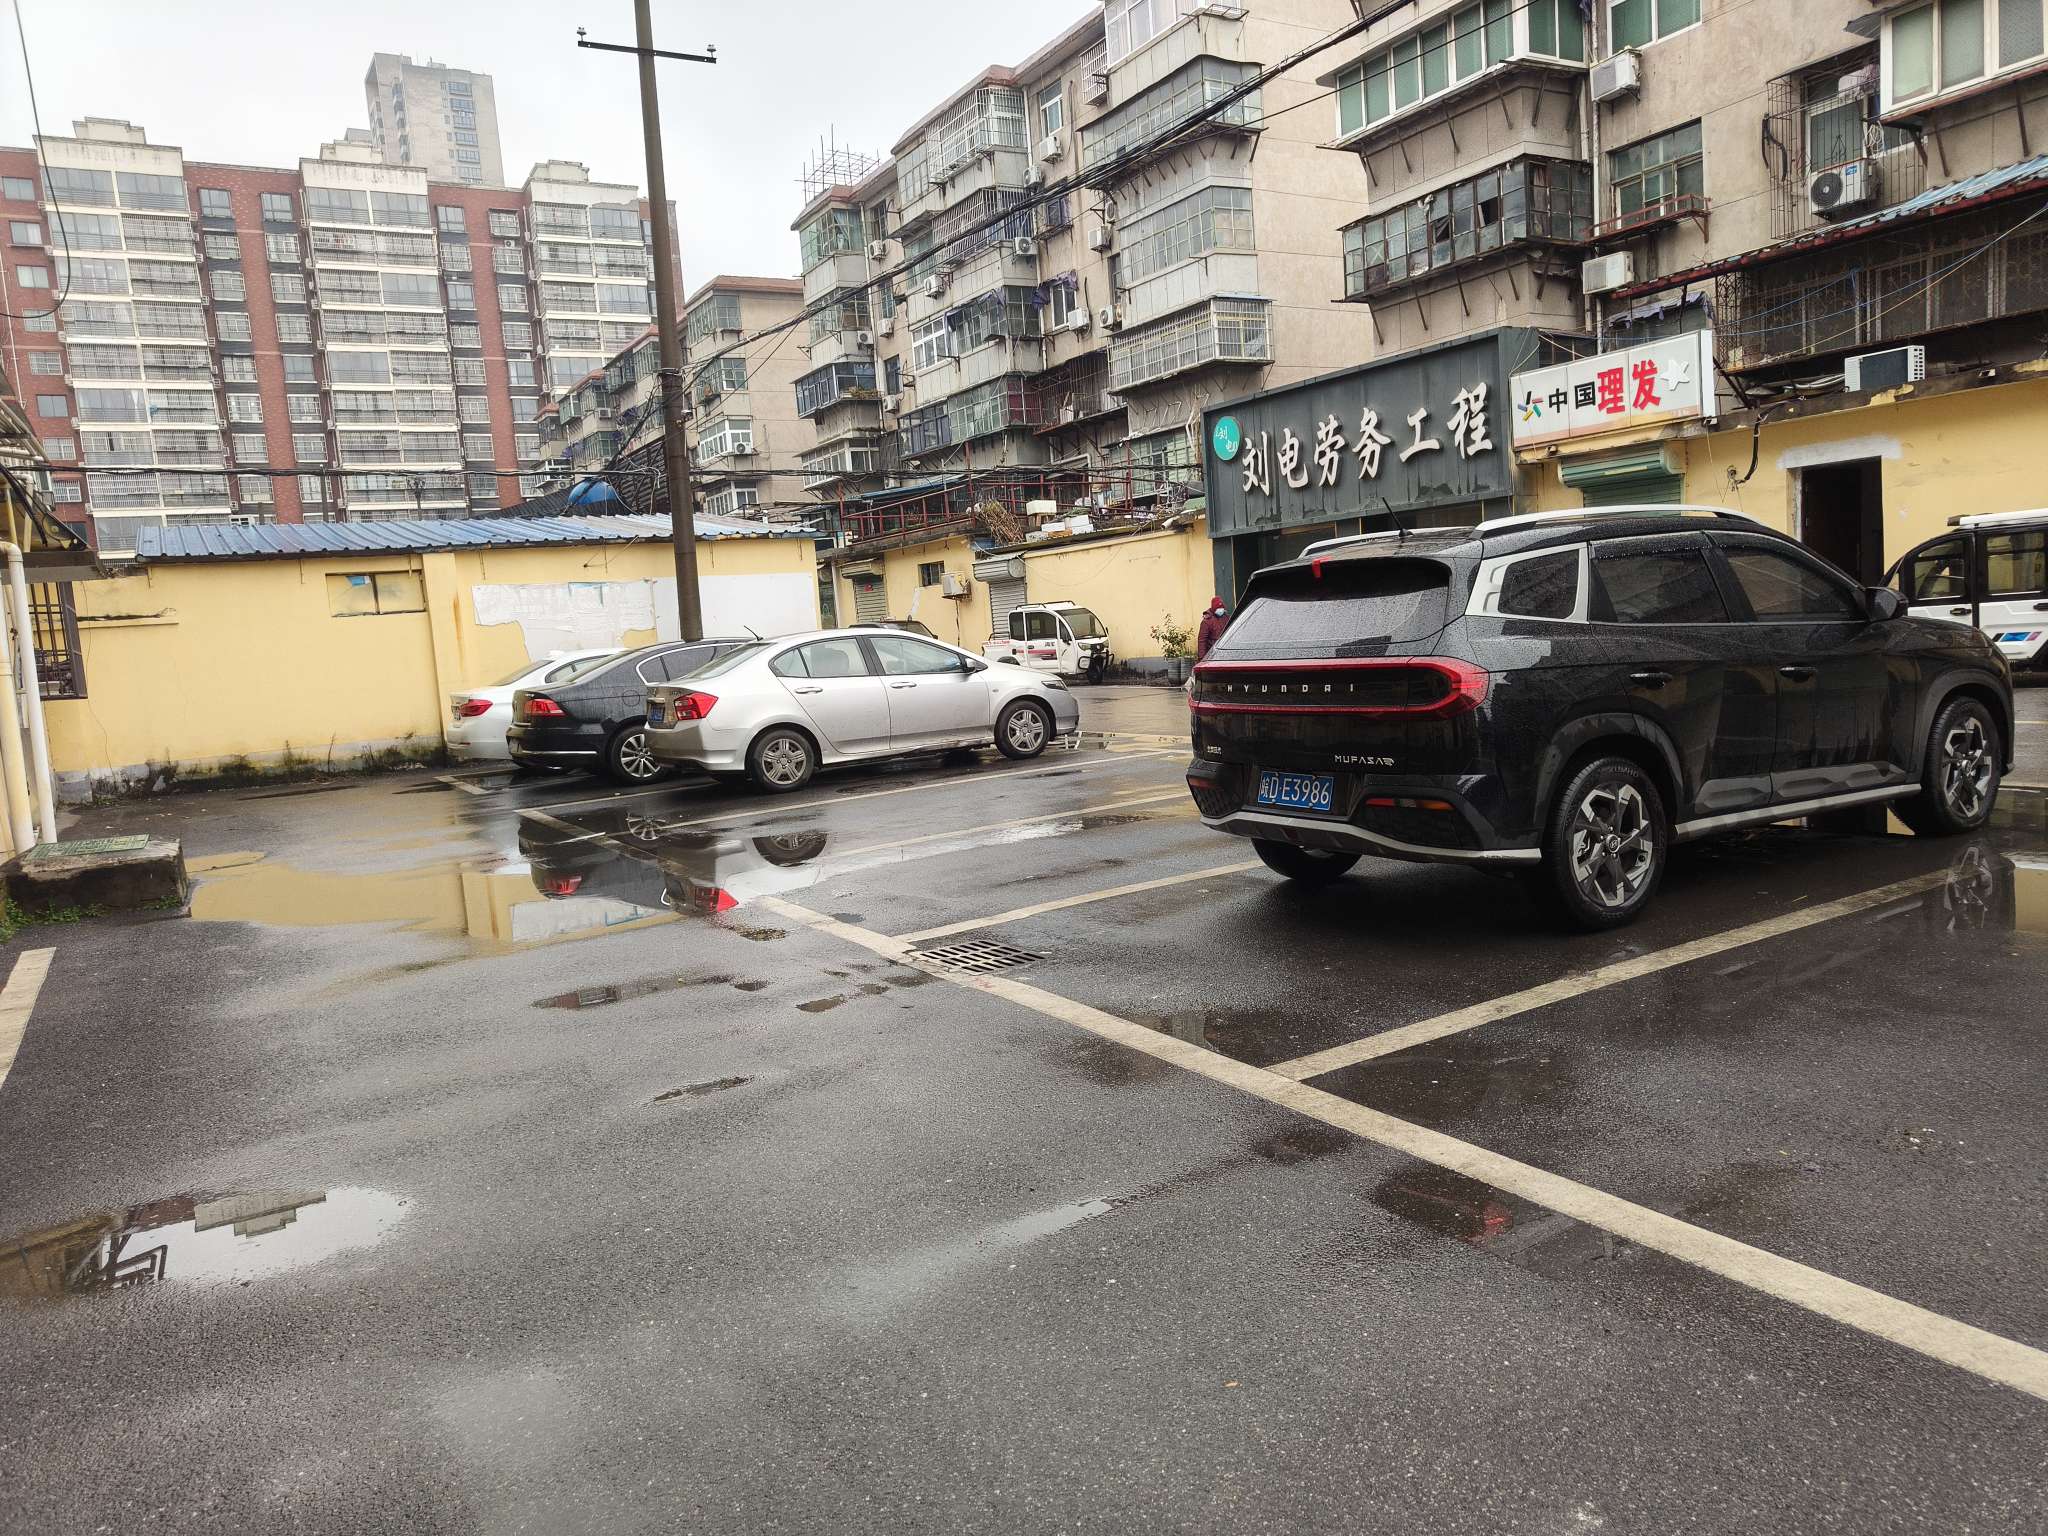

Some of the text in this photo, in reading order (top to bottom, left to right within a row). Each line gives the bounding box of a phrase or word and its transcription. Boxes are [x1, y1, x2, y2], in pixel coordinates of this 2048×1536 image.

[1548, 359, 1661, 415] 中国理发
[1242, 382, 1493, 497] 刘电劳务工程
[1227, 683, 1354, 693] HYUNDAI
[1334, 754, 1384, 766] MUFASA
